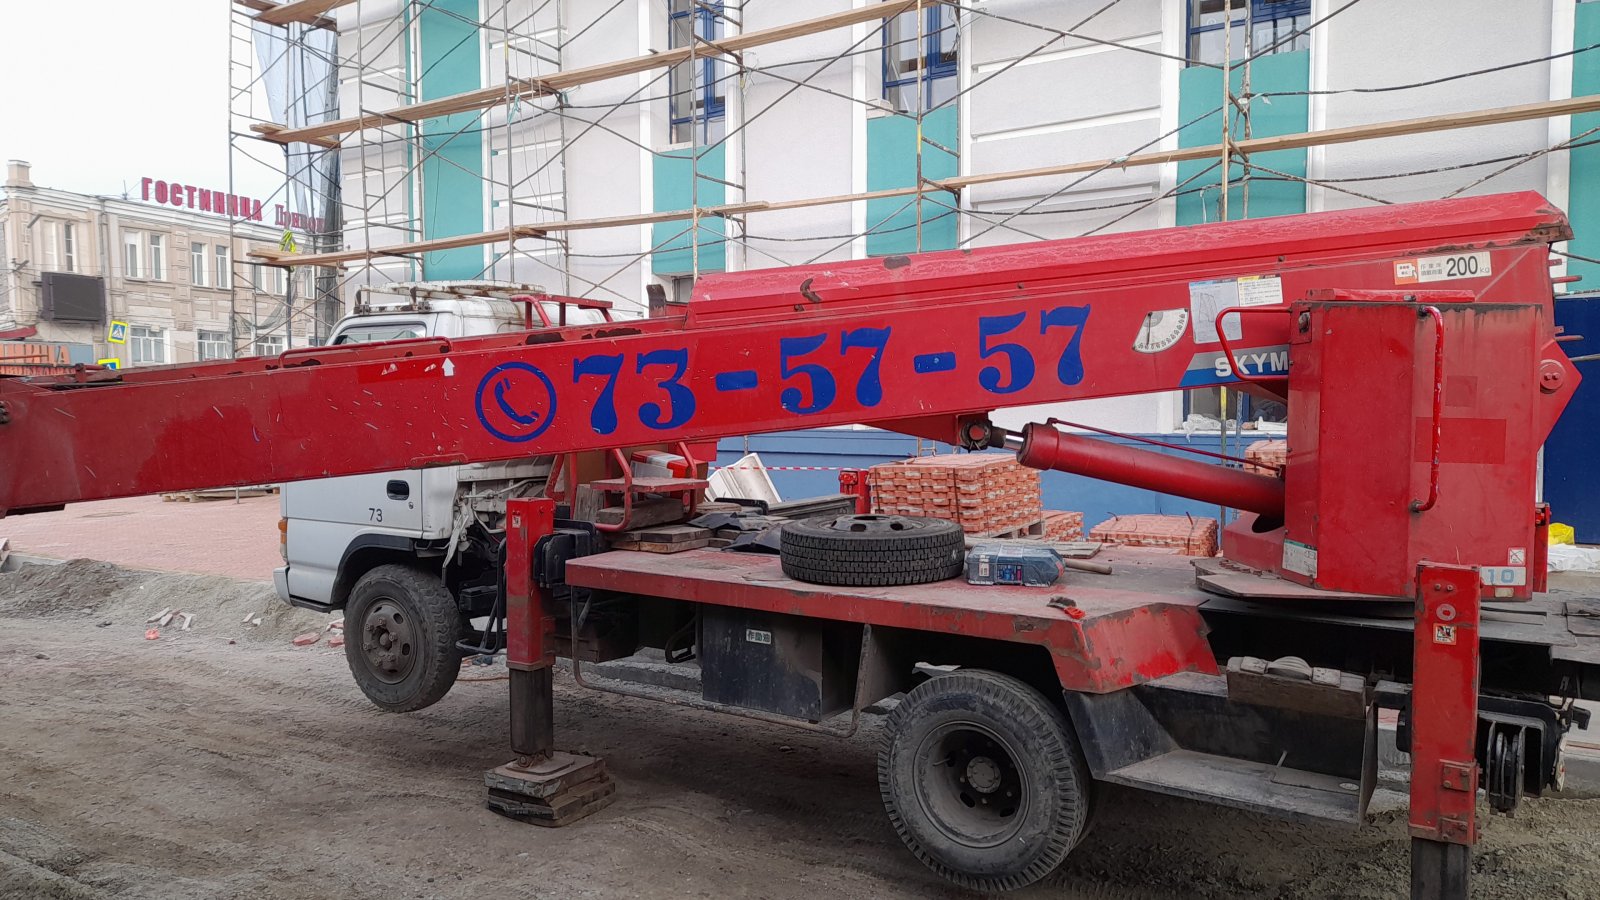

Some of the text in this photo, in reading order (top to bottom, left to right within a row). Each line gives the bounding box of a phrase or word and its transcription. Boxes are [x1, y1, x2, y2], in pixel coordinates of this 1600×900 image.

[141, 177, 262, 222] ГОСТИНИЦА
[1446, 256, 1478, 277] 200
[368, 507, 383, 523] 73
[1488, 569, 1514, 583] 10
